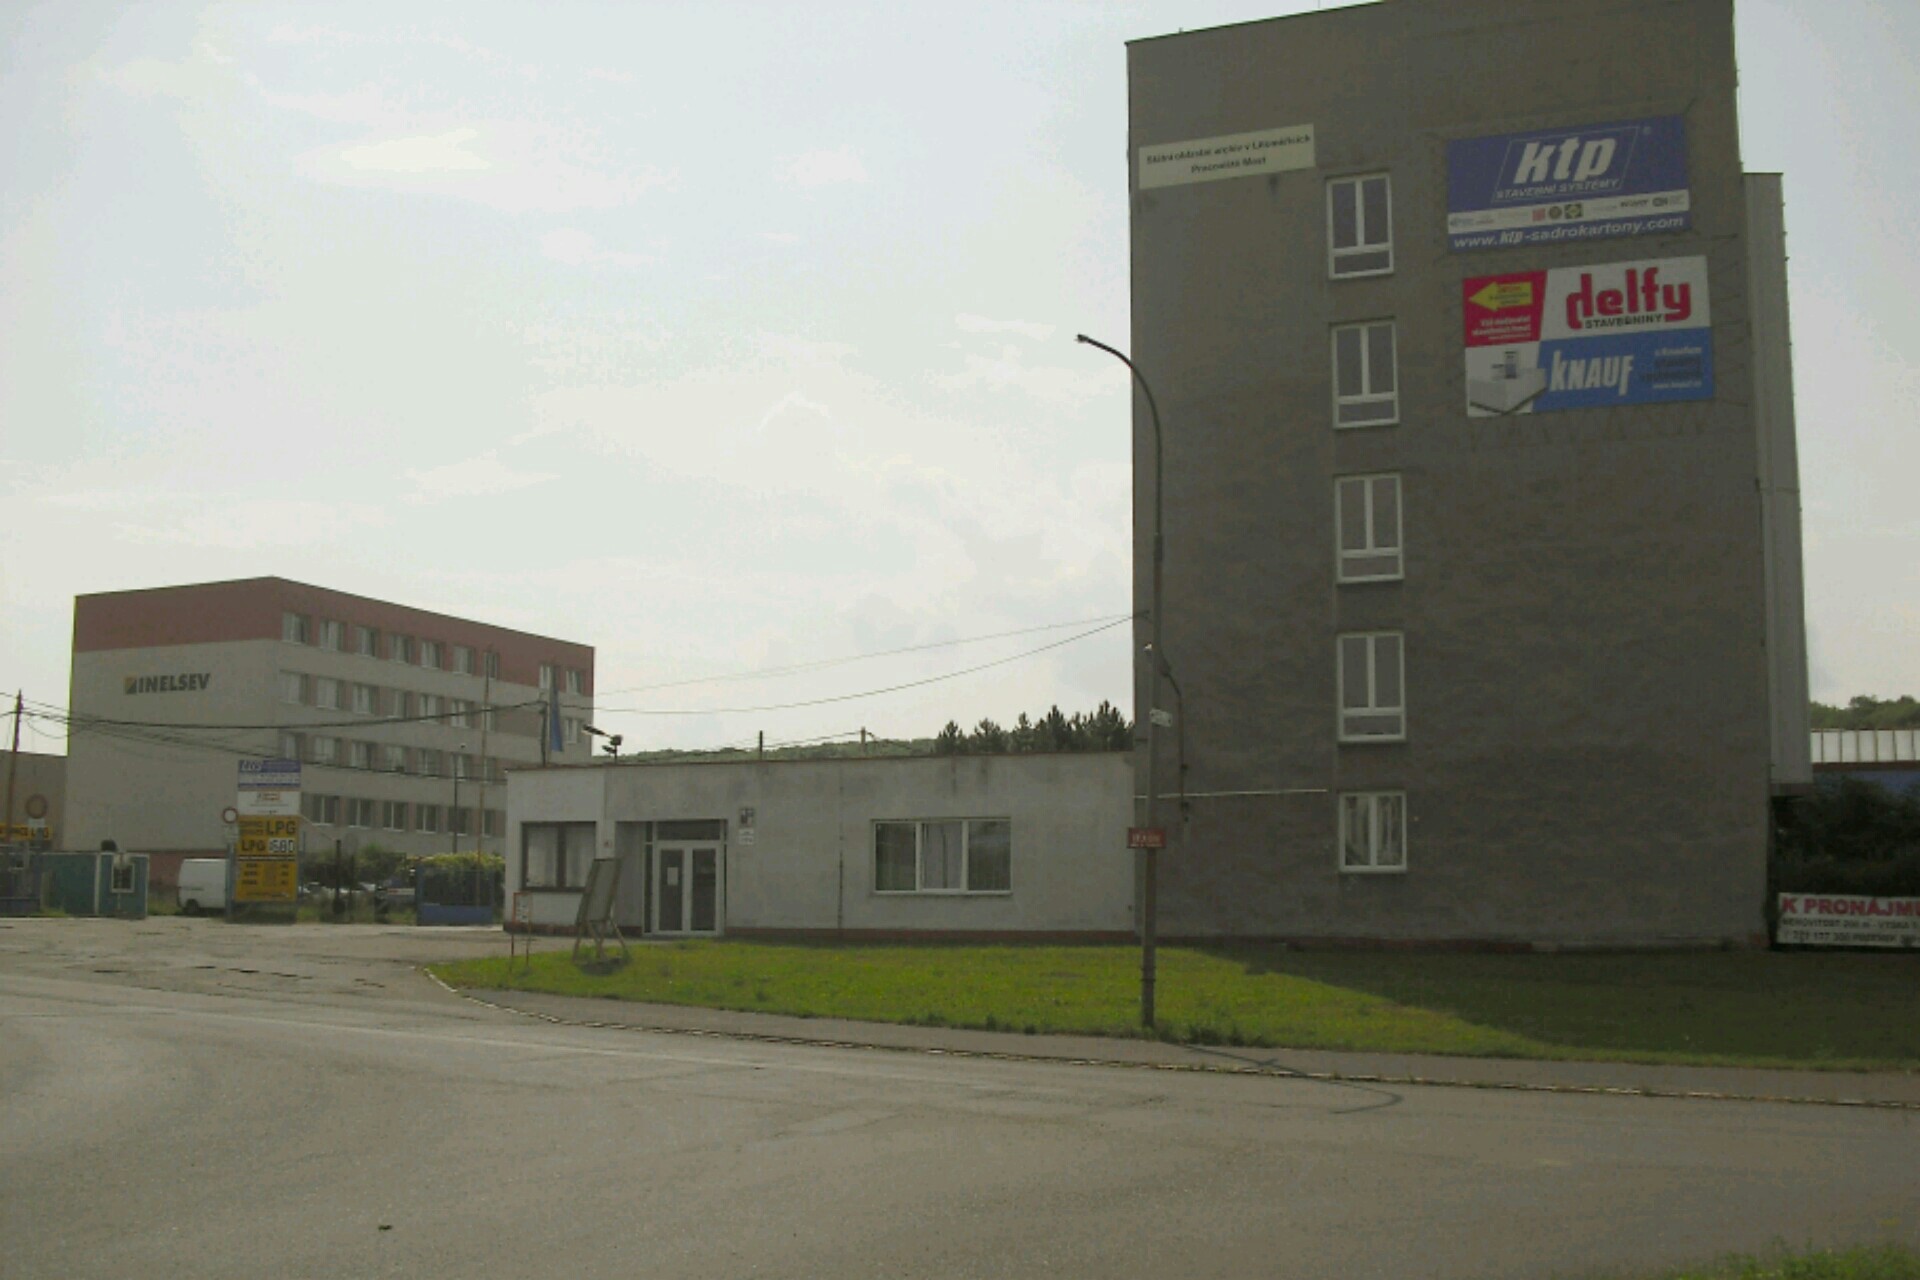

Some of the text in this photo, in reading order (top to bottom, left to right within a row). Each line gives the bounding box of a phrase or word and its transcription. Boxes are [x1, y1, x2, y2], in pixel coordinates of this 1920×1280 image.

[1513, 136, 1617, 184] ktp
[1566, 267, 1692, 330] delfy
[138, 673, 211, 693] INELSEV
[266, 820, 296, 835] LPG
[241, 839, 266, 851] LPG
[1781, 897, 1798, 914] K
